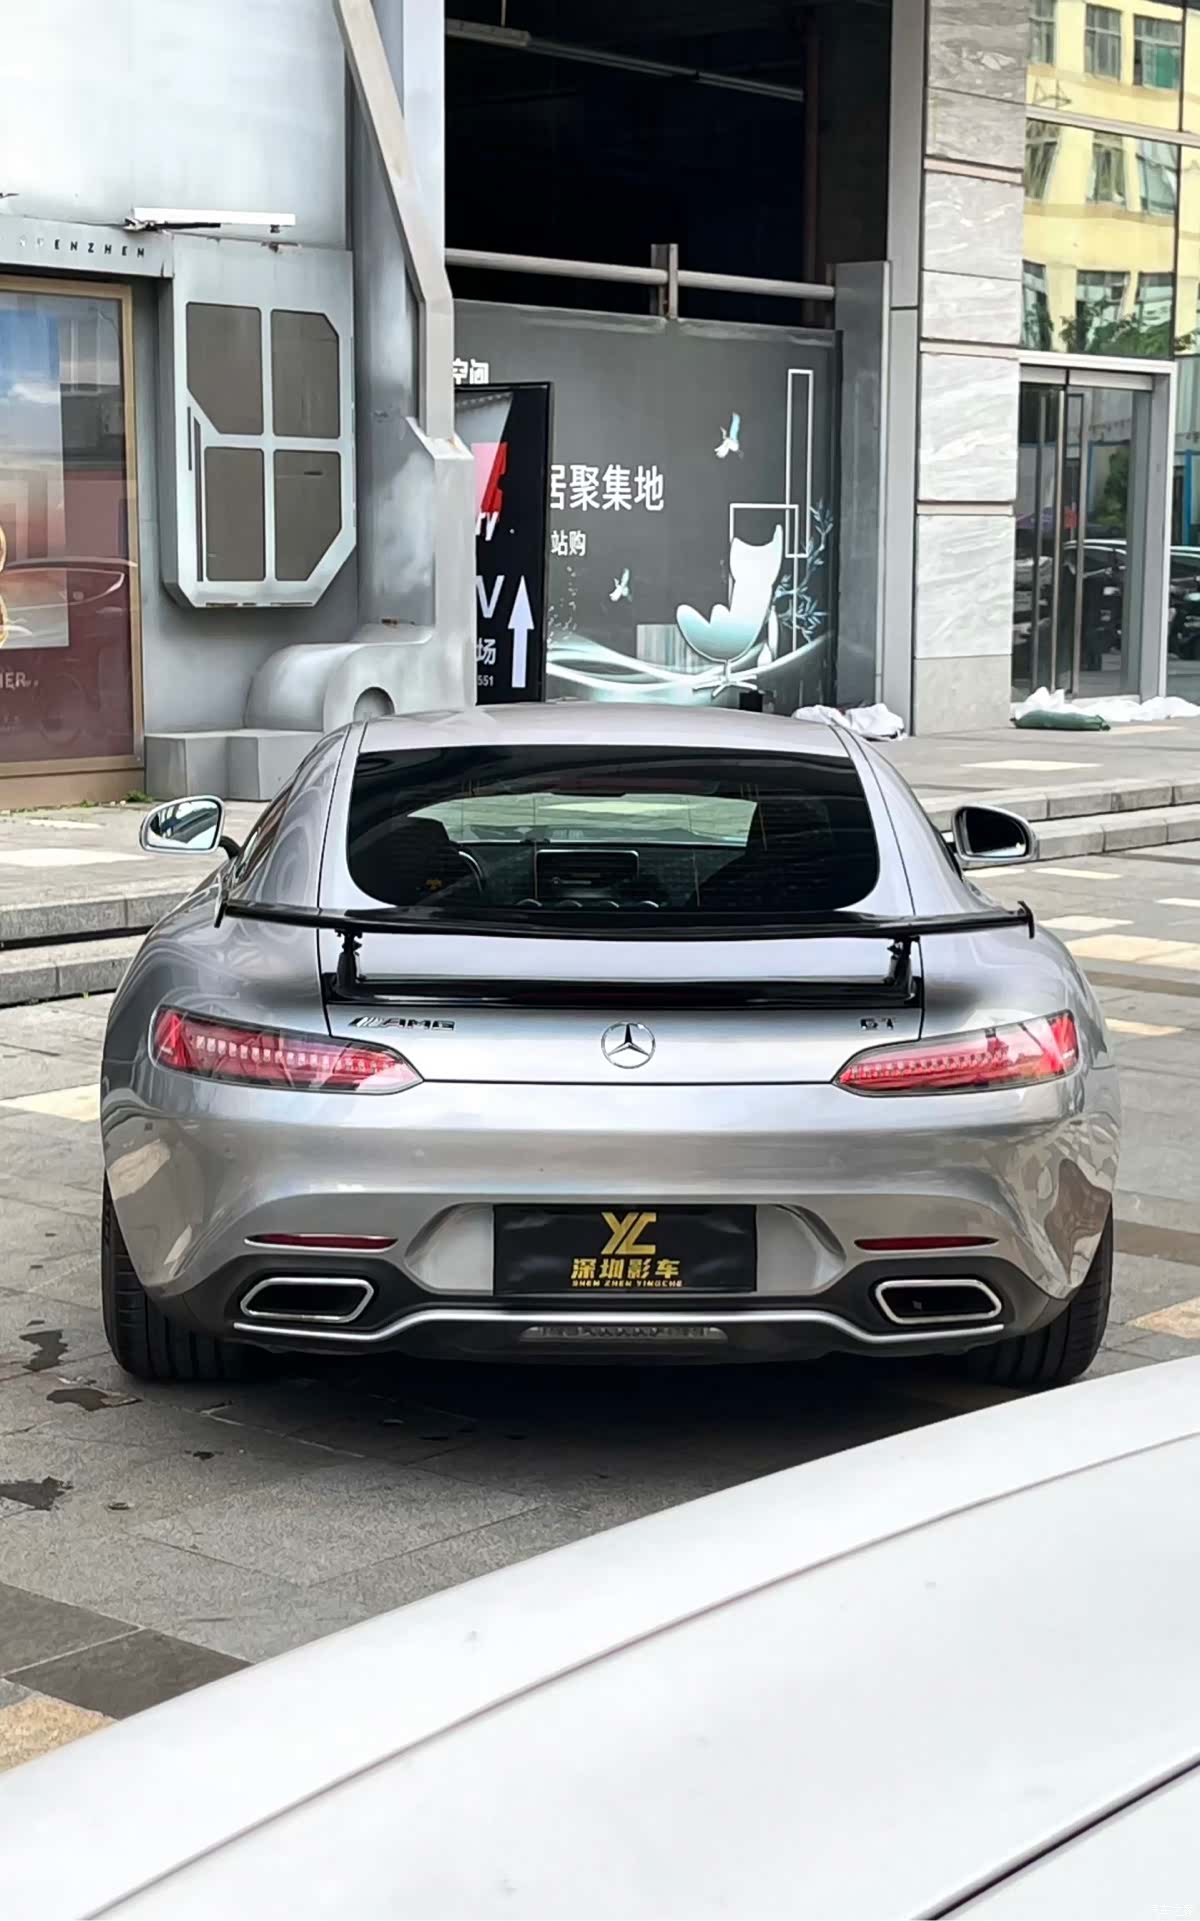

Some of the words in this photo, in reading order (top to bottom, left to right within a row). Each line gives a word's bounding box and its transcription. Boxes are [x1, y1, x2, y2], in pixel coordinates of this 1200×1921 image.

[19, 236, 145, 257] ENZHEN
[378, 1018, 455, 1030] AMG
[601, 1212, 656, 1255] YC
[571, 1258, 680, 1279] 深圳影车
